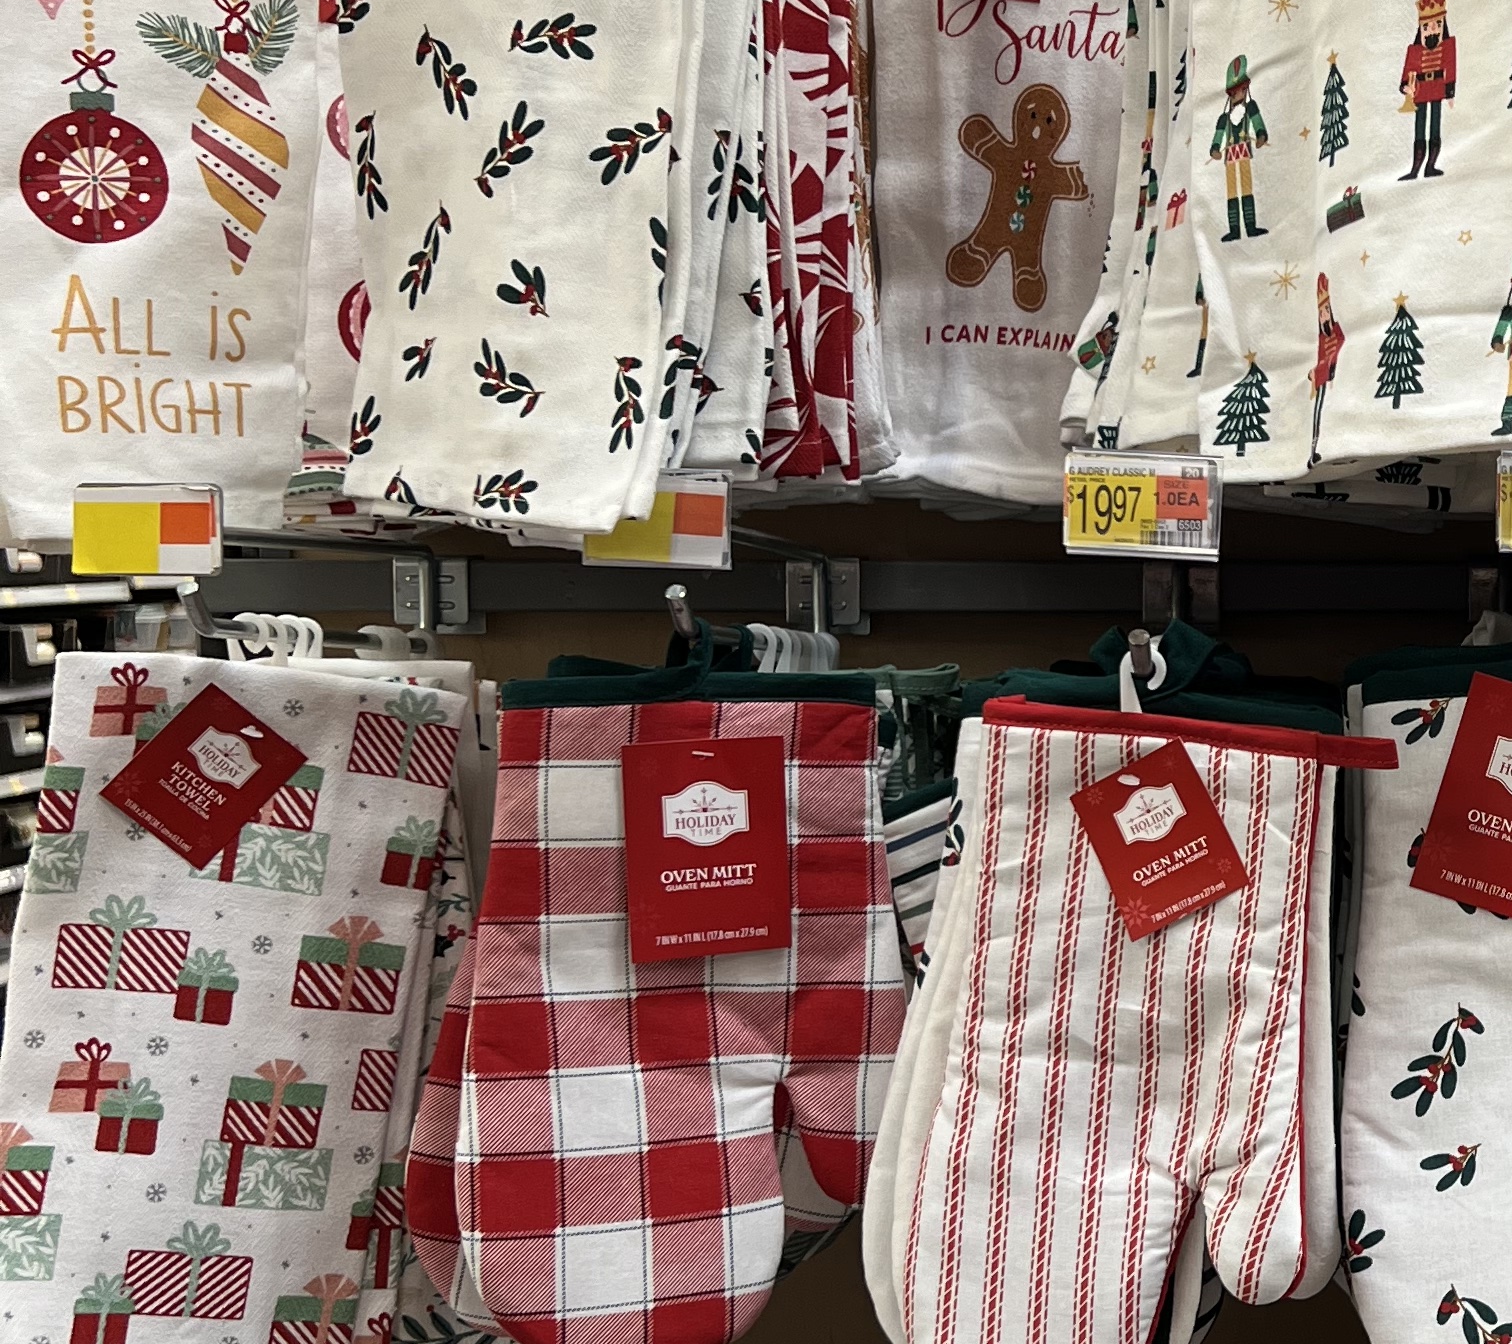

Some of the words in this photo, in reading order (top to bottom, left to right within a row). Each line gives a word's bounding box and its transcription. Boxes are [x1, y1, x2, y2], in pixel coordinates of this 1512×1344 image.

[51, 274, 171, 356] ALL
[925, 326, 931, 345] I
[940, 324, 989, 344] CAN
[1077, 466, 1110, 476] AUDREY
[1112, 468, 1146, 478] CLASSIC
[1164, 481, 1189, 489] SIZE
[1154, 492, 1199, 506] 1.0EA
[1178, 520, 1202, 530] 6503
[198, 745, 240, 779] HOLIDAY
[171, 762, 226, 805] KITCHEN
[169, 774, 211, 812] TOWEL
[675, 814, 736, 829] HOLIDAY
[1130, 806, 1174, 836] HOLIDAY
[692, 829, 722, 837] TIME
[1145, 822, 1168, 836] TIME
[1468, 824, 1500, 839] GUANTE
[1133, 855, 1171, 882] OVEN
[1173, 836, 1208, 861] MITT
[660, 868, 708, 884] OVEN
[712, 864, 757, 880] MITT
[666, 883, 698, 892] GUANTE
[700, 881, 721, 889] PARA
[723, 878, 753, 887] HORNO
